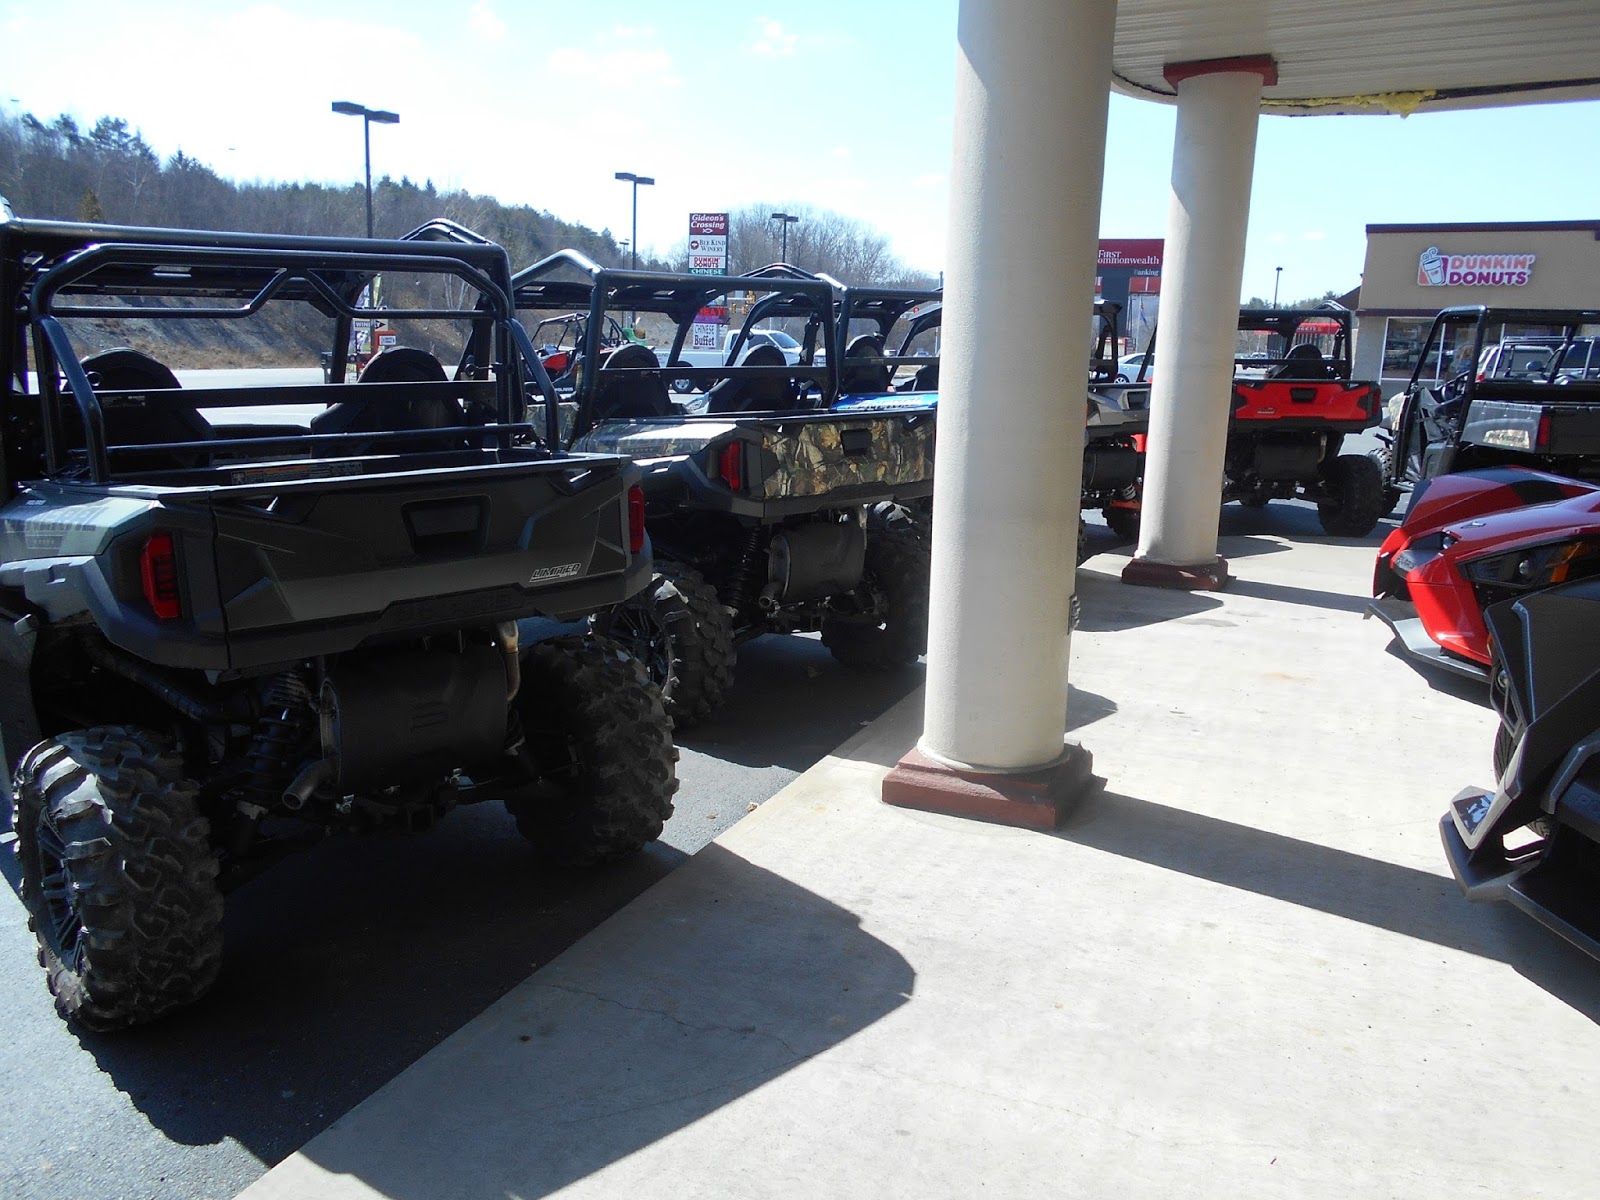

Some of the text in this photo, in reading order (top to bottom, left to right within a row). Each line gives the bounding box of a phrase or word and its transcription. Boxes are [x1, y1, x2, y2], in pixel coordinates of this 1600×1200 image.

[691, 221, 725, 229] Crossing
[1097, 256, 1159, 264] ommonwealth
[1449, 271, 1526, 285] DONUTS
[694, 335, 715, 346] Buffet
[530, 563, 581, 579] LIMITED
